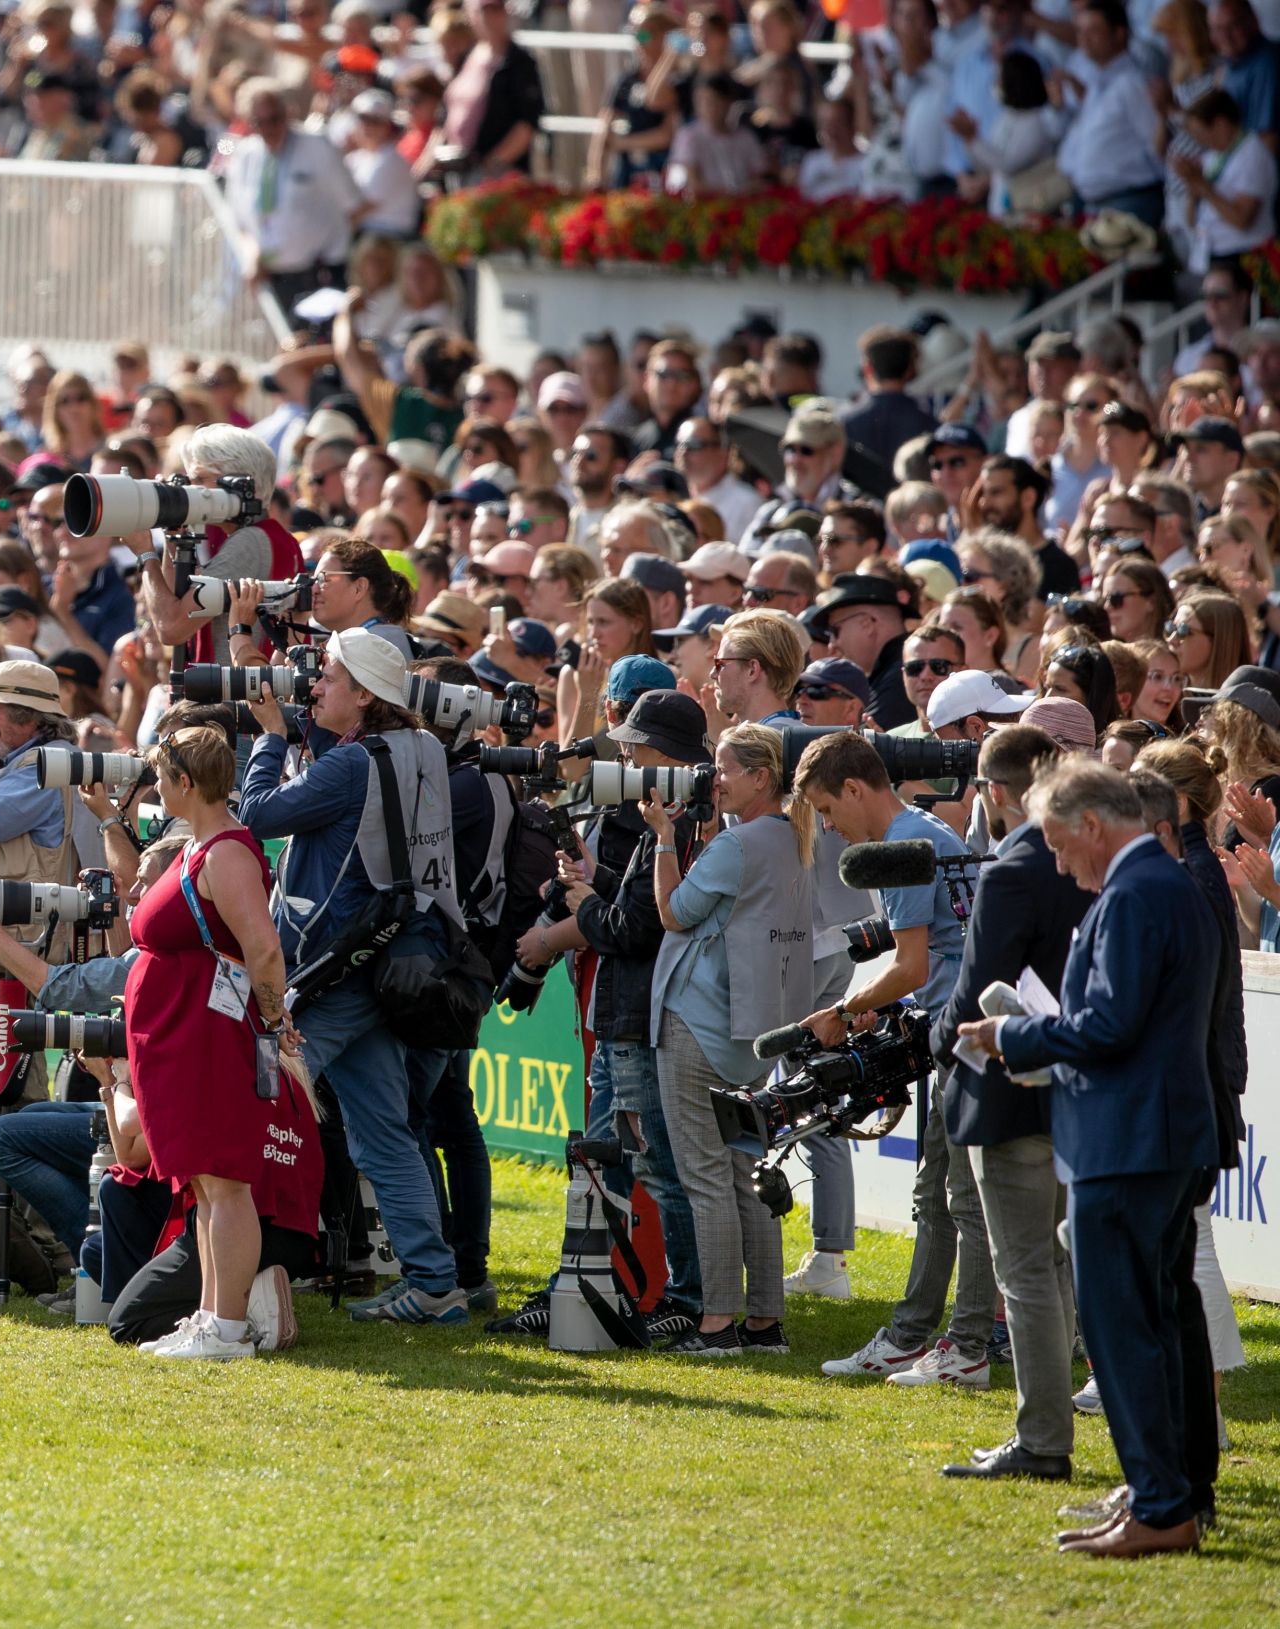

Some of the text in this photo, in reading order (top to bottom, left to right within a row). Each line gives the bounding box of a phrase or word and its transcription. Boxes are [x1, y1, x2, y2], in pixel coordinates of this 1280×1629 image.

[421, 856, 451, 890] 49
[76, 936, 85, 963] anon
[18, 1053, 31, 1079] Canon
[619, 1293, 633, 1318] Canon
